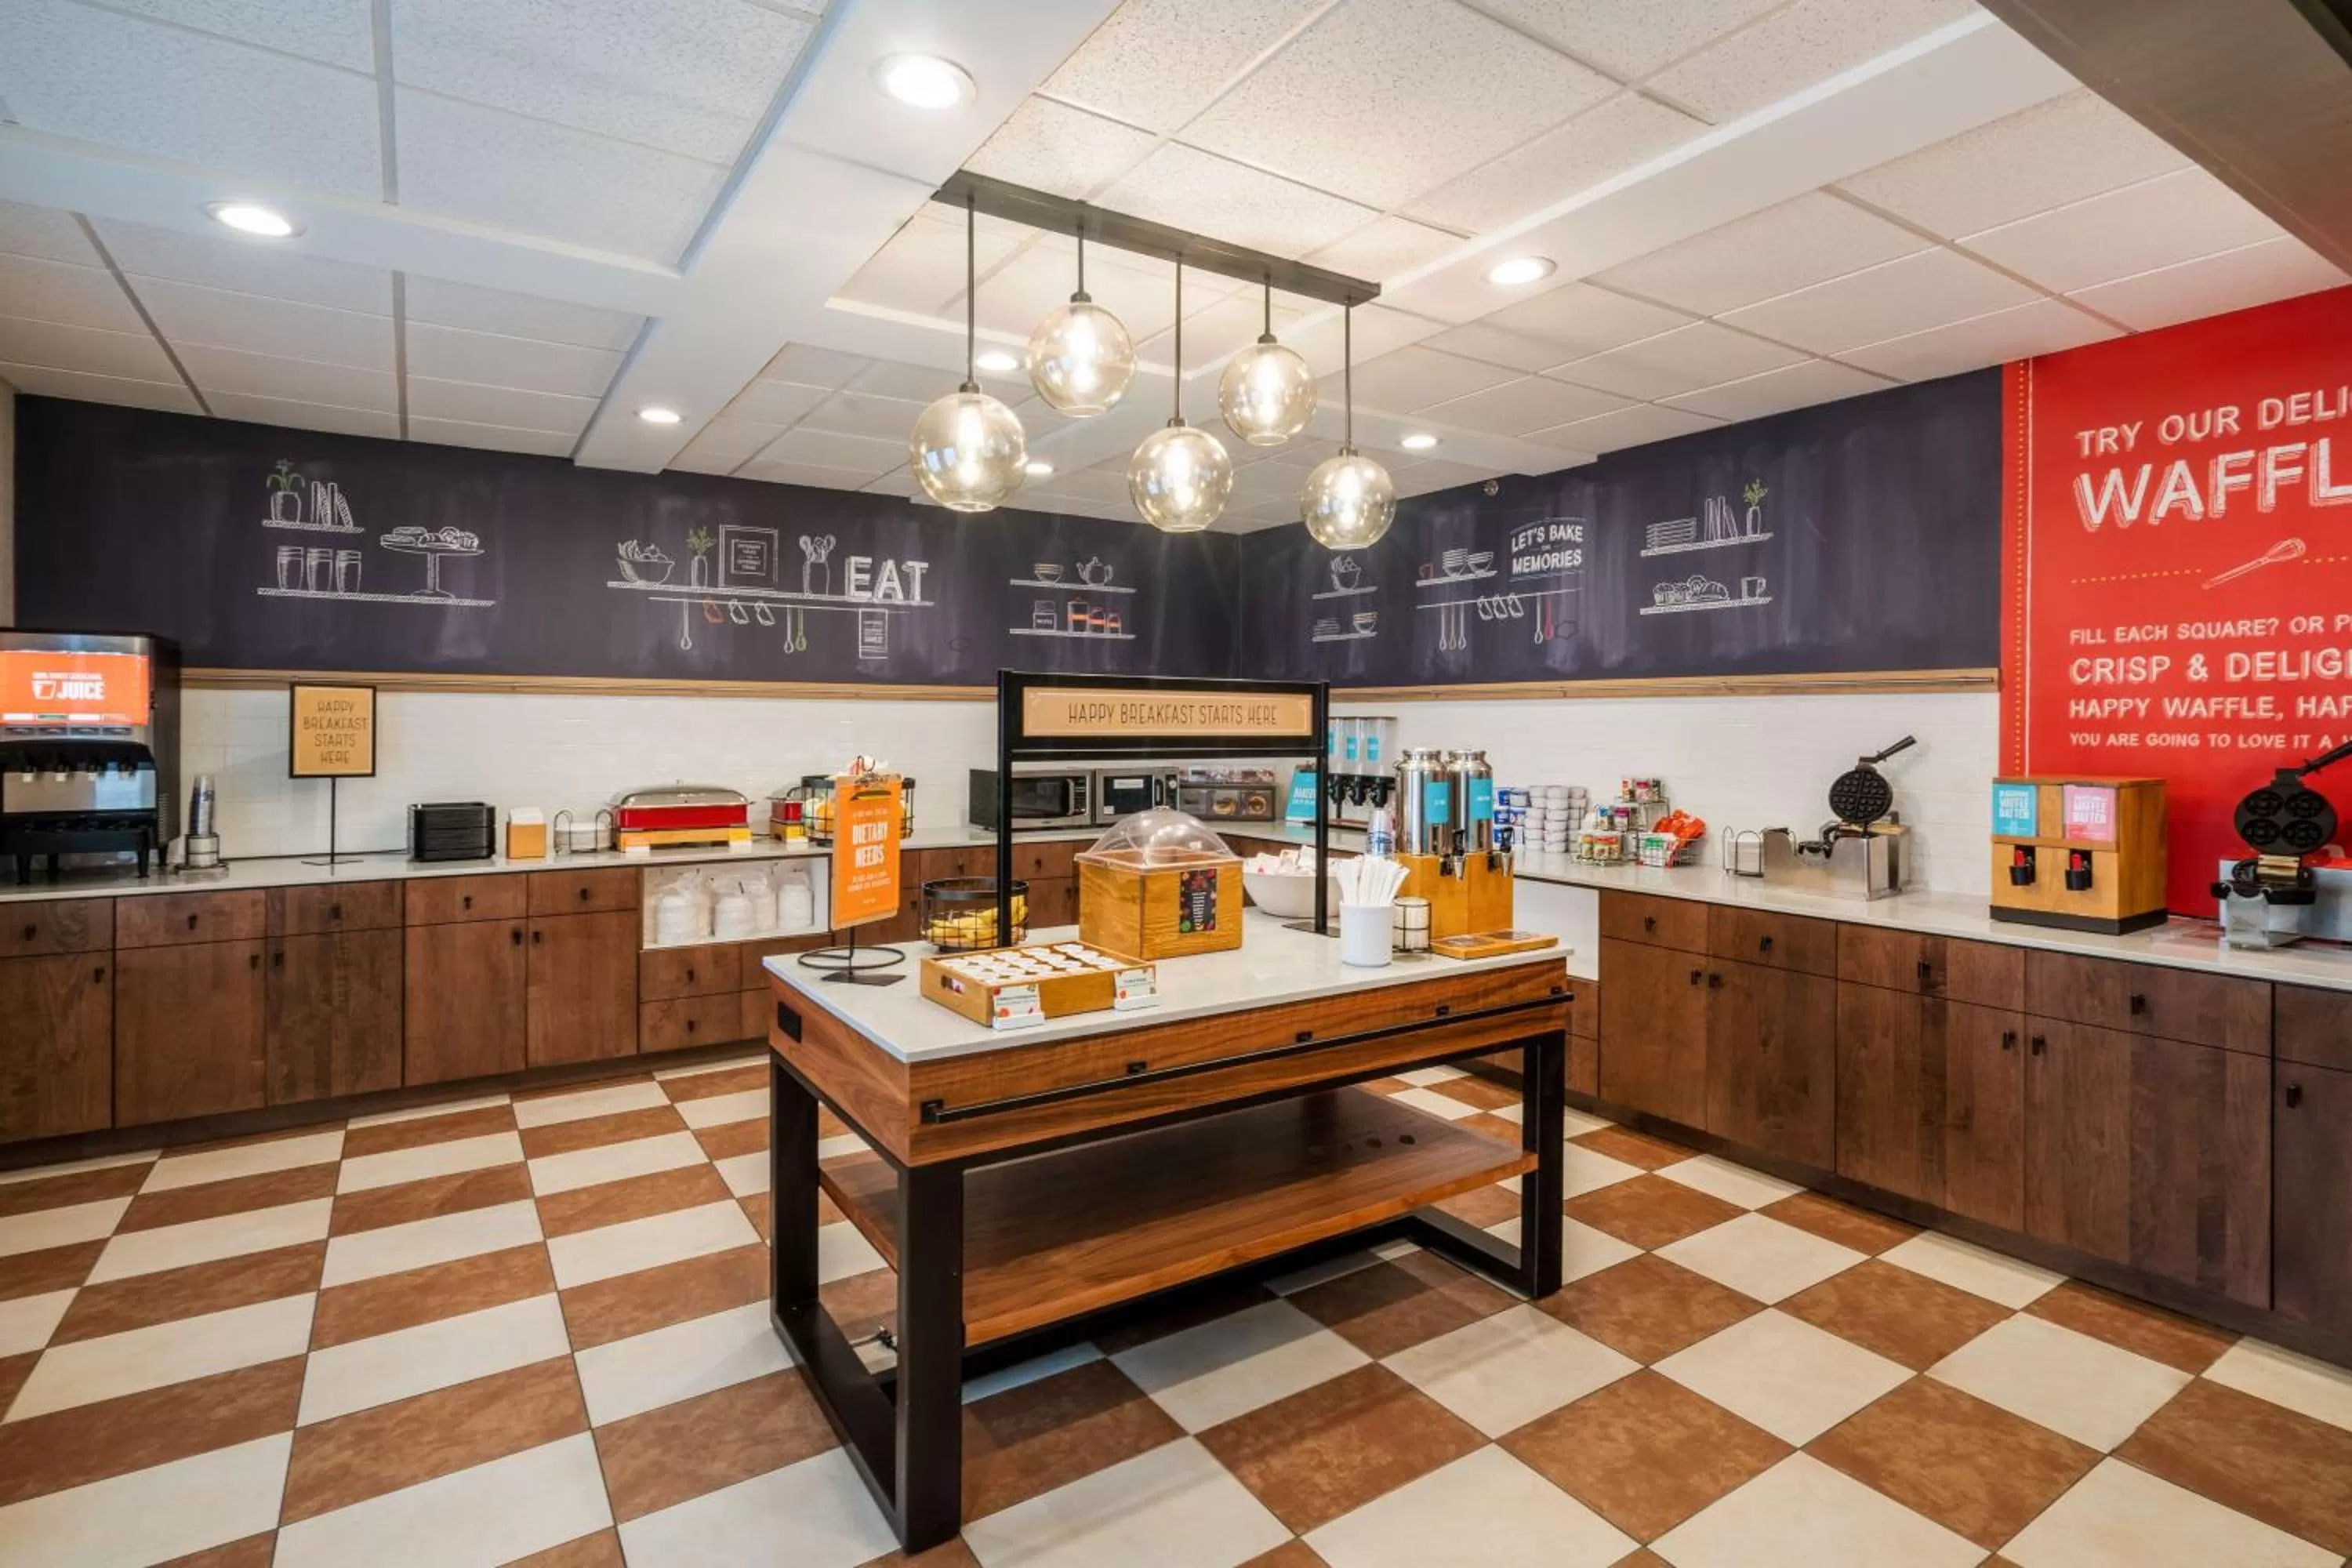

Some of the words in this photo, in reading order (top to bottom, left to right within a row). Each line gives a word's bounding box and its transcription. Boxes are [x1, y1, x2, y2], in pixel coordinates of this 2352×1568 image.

[2074, 420, 2143, 459] TRY
[2158, 405, 2241, 446] OUR
[2258, 385, 2352, 430] DELI
[2073, 437, 2352, 533] WAFFL
[1512, 526, 1545, 554] LET'S
[1549, 524, 1584, 543] BAKE
[1512, 549, 1581, 575] MEMORIES
[845, 556, 929, 603] EAT
[2069, 628, 2107, 645] FILL
[2114, 624, 2169, 644] EACH
[2176, 617, 2280, 641] SQUARE?
[2289, 615, 2325, 634] OR
[2333, 614, 2352, 633] P
[2069, 654, 2172, 686] CRISP
[2186, 652, 2209, 683] &
[56, 681, 105, 701] JUICE
[1068, 702, 1115, 724] HAPPY
[1120, 702, 1196, 724] BREAKFAST
[1199, 704, 1243, 724] STARTS
[1247, 704, 1278, 726] HERE
[2068, 697, 2151, 719] HAPPY
[2162, 695, 2284, 721] WAFFLE,
[2069, 731, 2102, 747] YOU
[2105, 732, 2140, 746] ARE
[2145, 732, 2201, 748] GOING
[2207, 733, 2232, 748] TO
[2238, 733, 2287, 749] LOVE
[2292, 734, 2312, 750] IT
[2318, 734, 2334, 750] A
[852, 821, 888, 845] DIETARY
[855, 844, 884, 868] NEEDS
